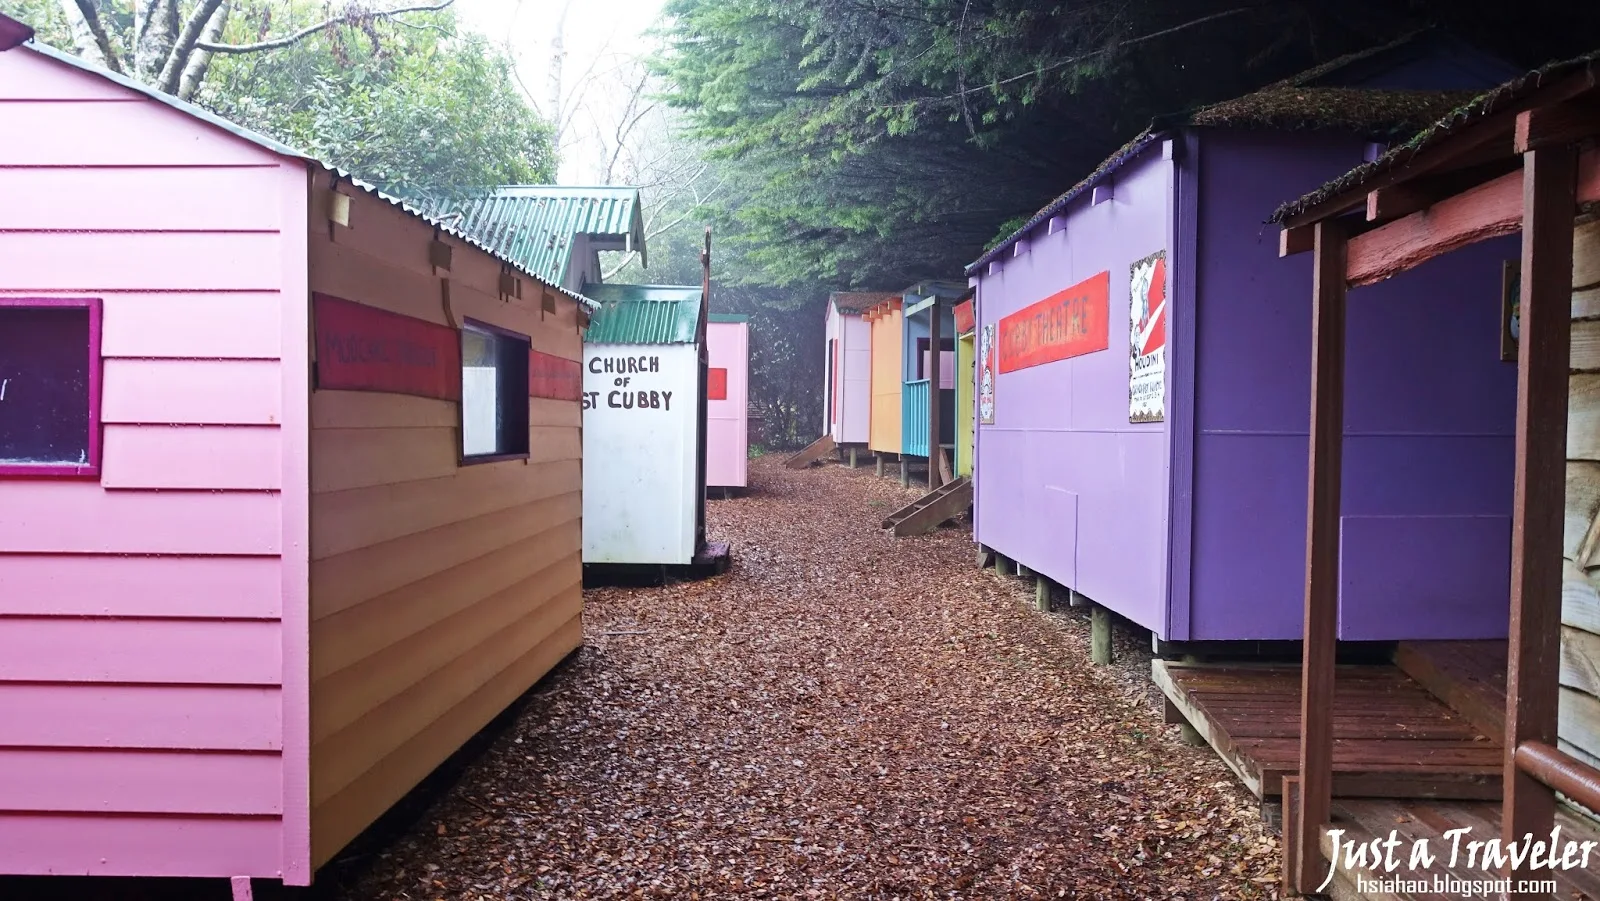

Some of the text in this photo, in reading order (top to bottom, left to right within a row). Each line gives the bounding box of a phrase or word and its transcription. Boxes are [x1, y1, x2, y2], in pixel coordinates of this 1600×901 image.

[1036, 296, 1088, 347] THEATRE
[588, 356, 660, 374] CHURCH
[1134, 353, 1159, 372] HOUDINI
[613, 377, 631, 388] OF
[583, 390, 673, 411] ST CUBBY
